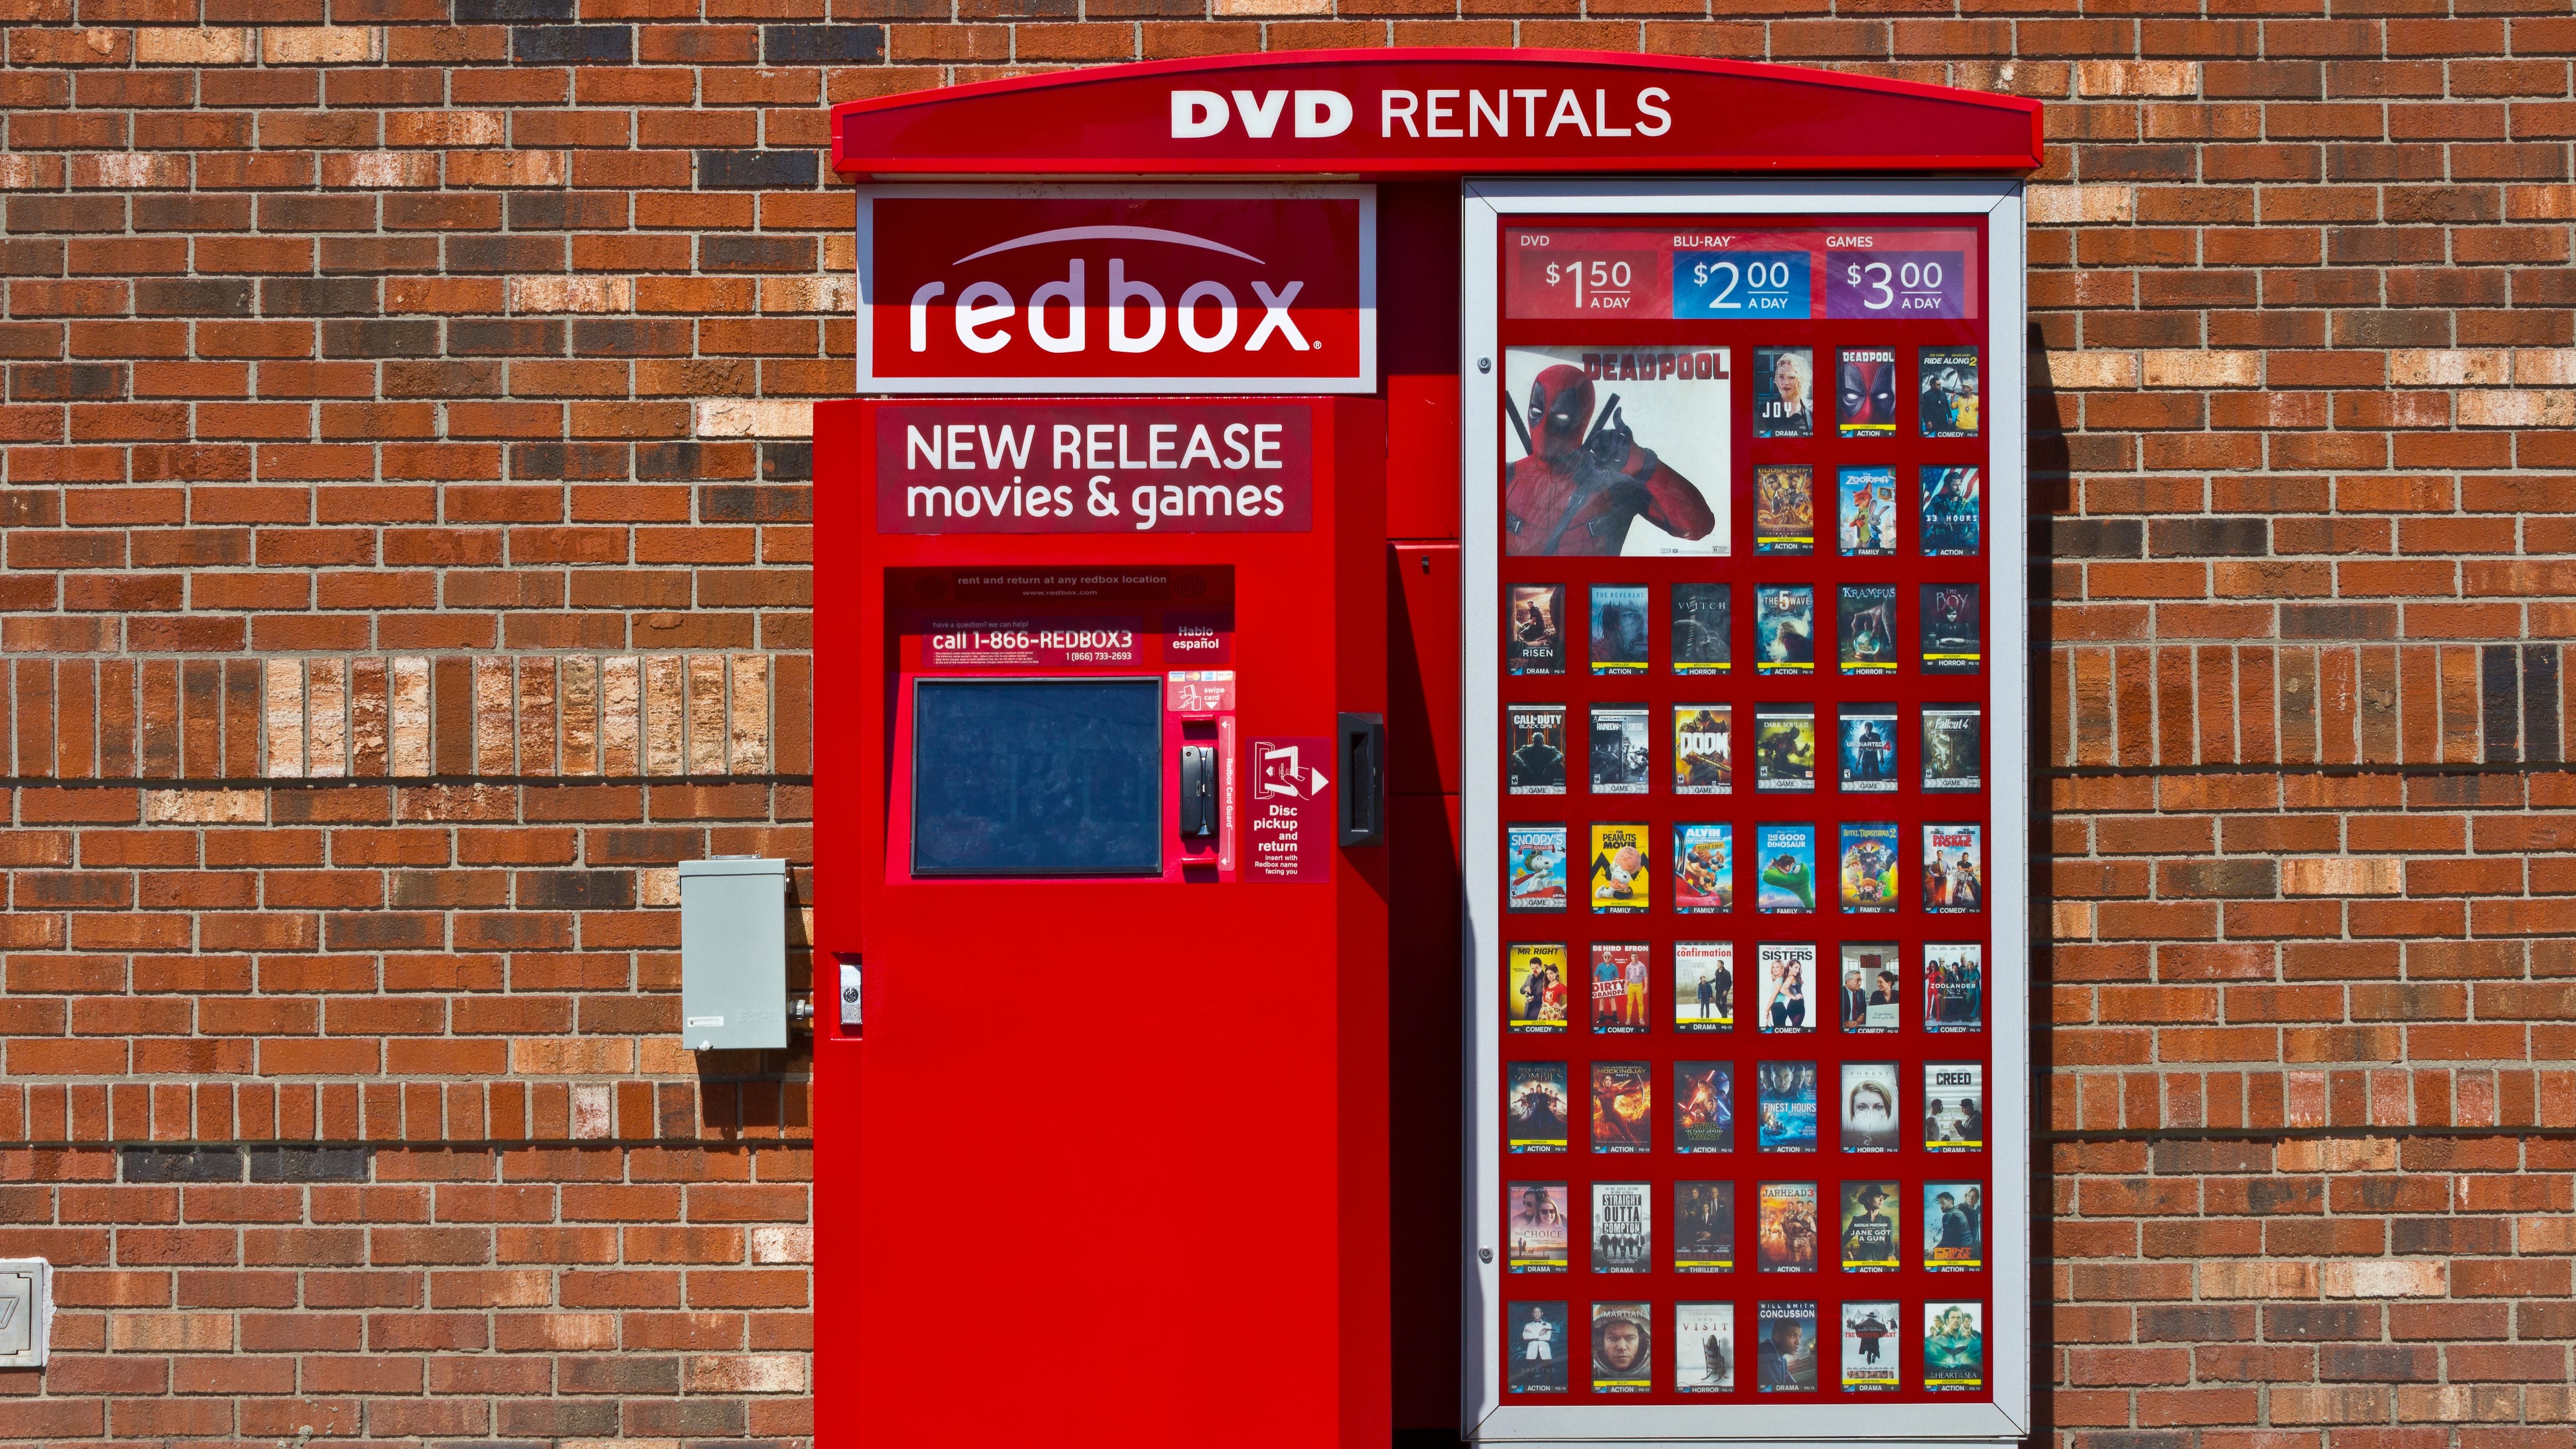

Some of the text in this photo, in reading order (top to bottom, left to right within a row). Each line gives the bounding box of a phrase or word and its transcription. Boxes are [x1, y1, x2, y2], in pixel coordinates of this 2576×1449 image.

[1170, 88, 1672, 139] DVD RENTALS
[1520, 236, 1549, 246] DVD
[1826, 236, 1873, 247] GAMES
[1591, 298, 1631, 308] A DAY
[1749, 298, 1788, 308] A DAY
[1902, 298, 1941, 308] A DAY
[1843, 352, 1894, 362] DEADPOOL
[1969, 357, 1977, 366] 2
[1583, 353, 1728, 380] DEADPOOL
[1762, 402, 1792, 418] JOY
[907, 424, 1282, 470] NEW RELEASE
[1846, 476, 1889, 484] ZOOTOPIA
[907, 476, 1283, 531] movies & games
[958, 576, 980, 584] rent
[984, 576, 1004, 584] and
[1008, 576, 1040, 584] return
[1058, 576, 1077, 585] any
[1081, 575, 1118, 583] redbox
[1122, 574, 1166, 583] location
[1179, 627, 1213, 636] Hablo
[933, 631, 1132, 649] call 1-866-REDBOX3
[1173, 638, 1218, 651] español
[1071, 652, 1092, 661] (866)
[1095, 652, 1131, 660] 733-2693
[1514, 715, 1561, 724] CALL DUTY
[1935, 719, 1969, 729] Fallout 4
[1681, 732, 1728, 759] DOOM
[1883, 742, 1891, 751] 4
[1270, 805, 1297, 815] Disc
[1254, 819, 1297, 831] pickup
[1686, 828, 1720, 837] ALVIN
[1512, 834, 1563, 846] SNOOPY'S
[1259, 841, 1297, 851] return
[1677, 949, 1731, 958] confirmation
[1762, 951, 1812, 960] SISTERS
[1592, 980, 1625, 992] DIRTY
[1592, 990, 1625, 998] GRANDPA
[1937, 1073, 1971, 1085] CREED
[1764, 1103, 1816, 1112] FINEST HOURS
[1604, 1196, 1639, 1205] STRAIGHT
[1604, 1207, 1639, 1222] OUTTA
[1604, 1223, 1639, 1233] COMPTON
